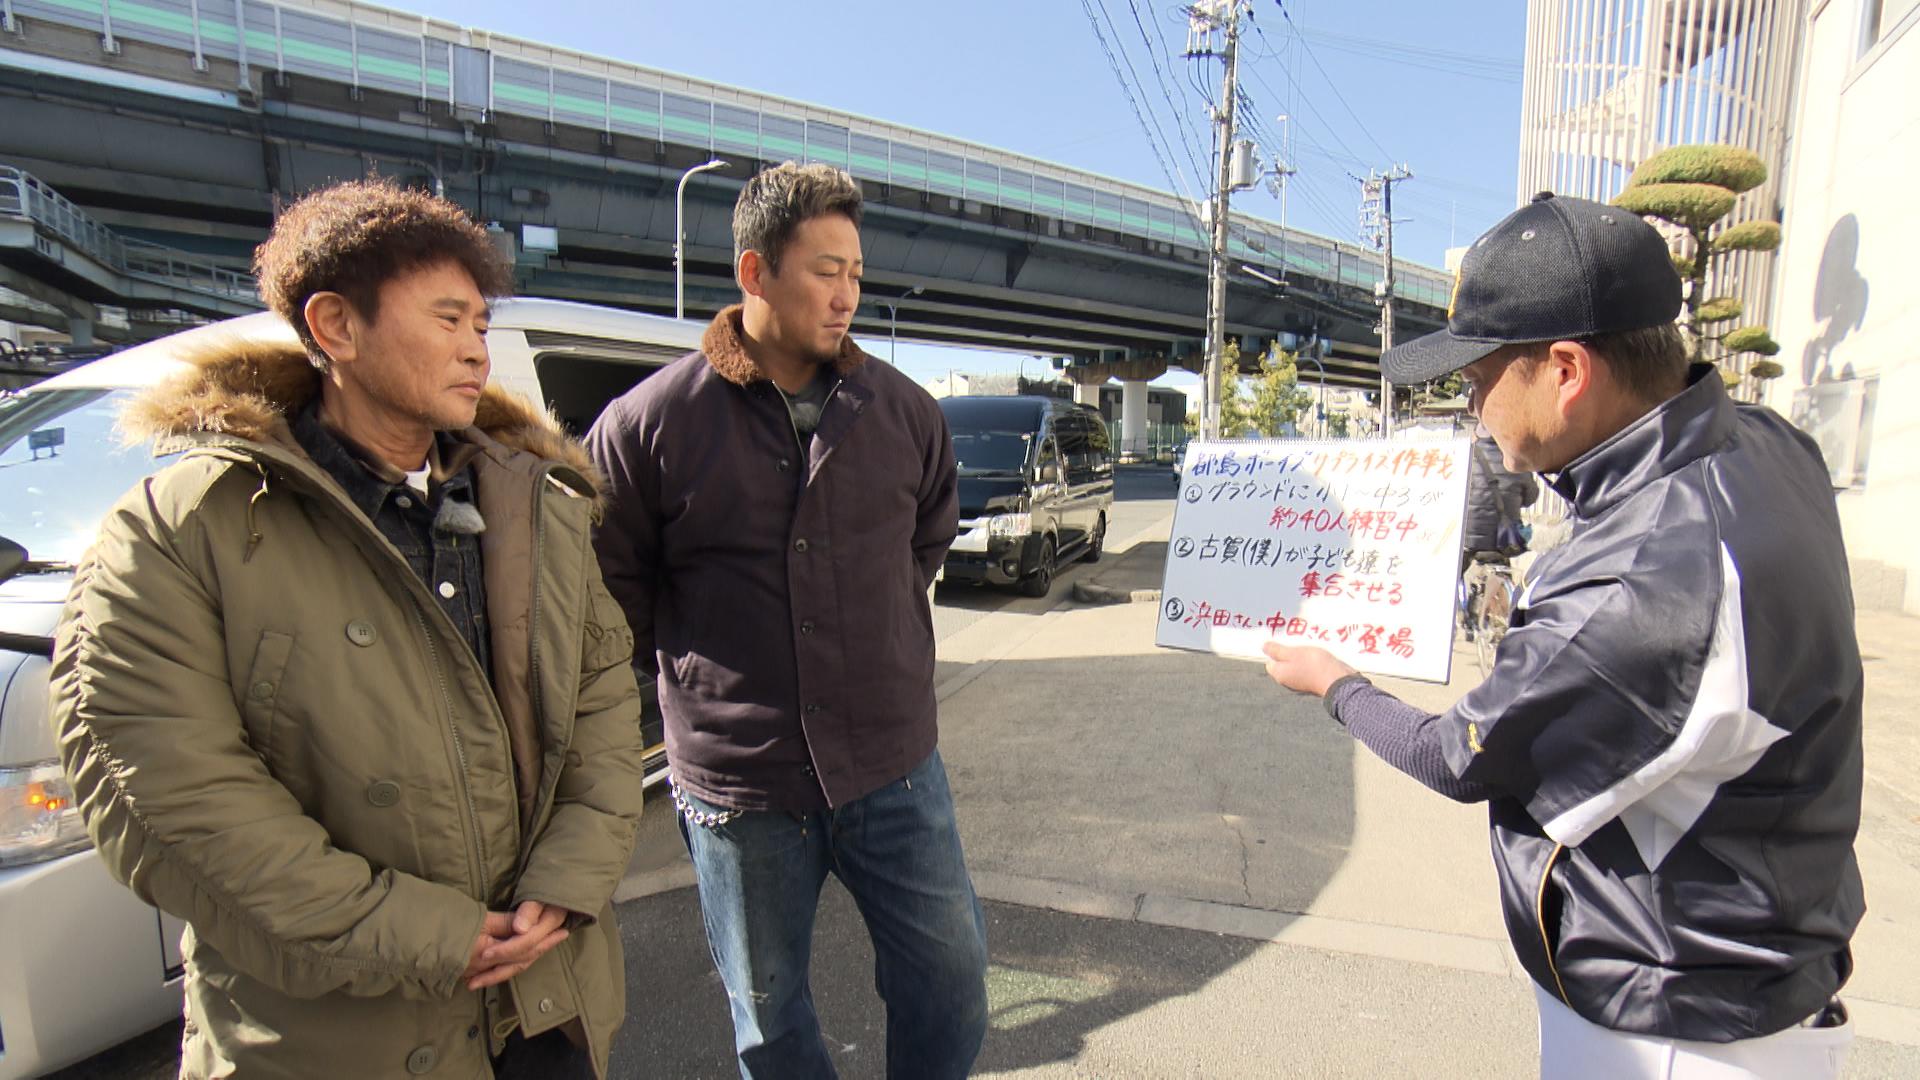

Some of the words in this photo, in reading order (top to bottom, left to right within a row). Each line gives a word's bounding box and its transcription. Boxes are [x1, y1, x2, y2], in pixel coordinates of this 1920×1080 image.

[1299, 572, 1403, 605] 集合させる
